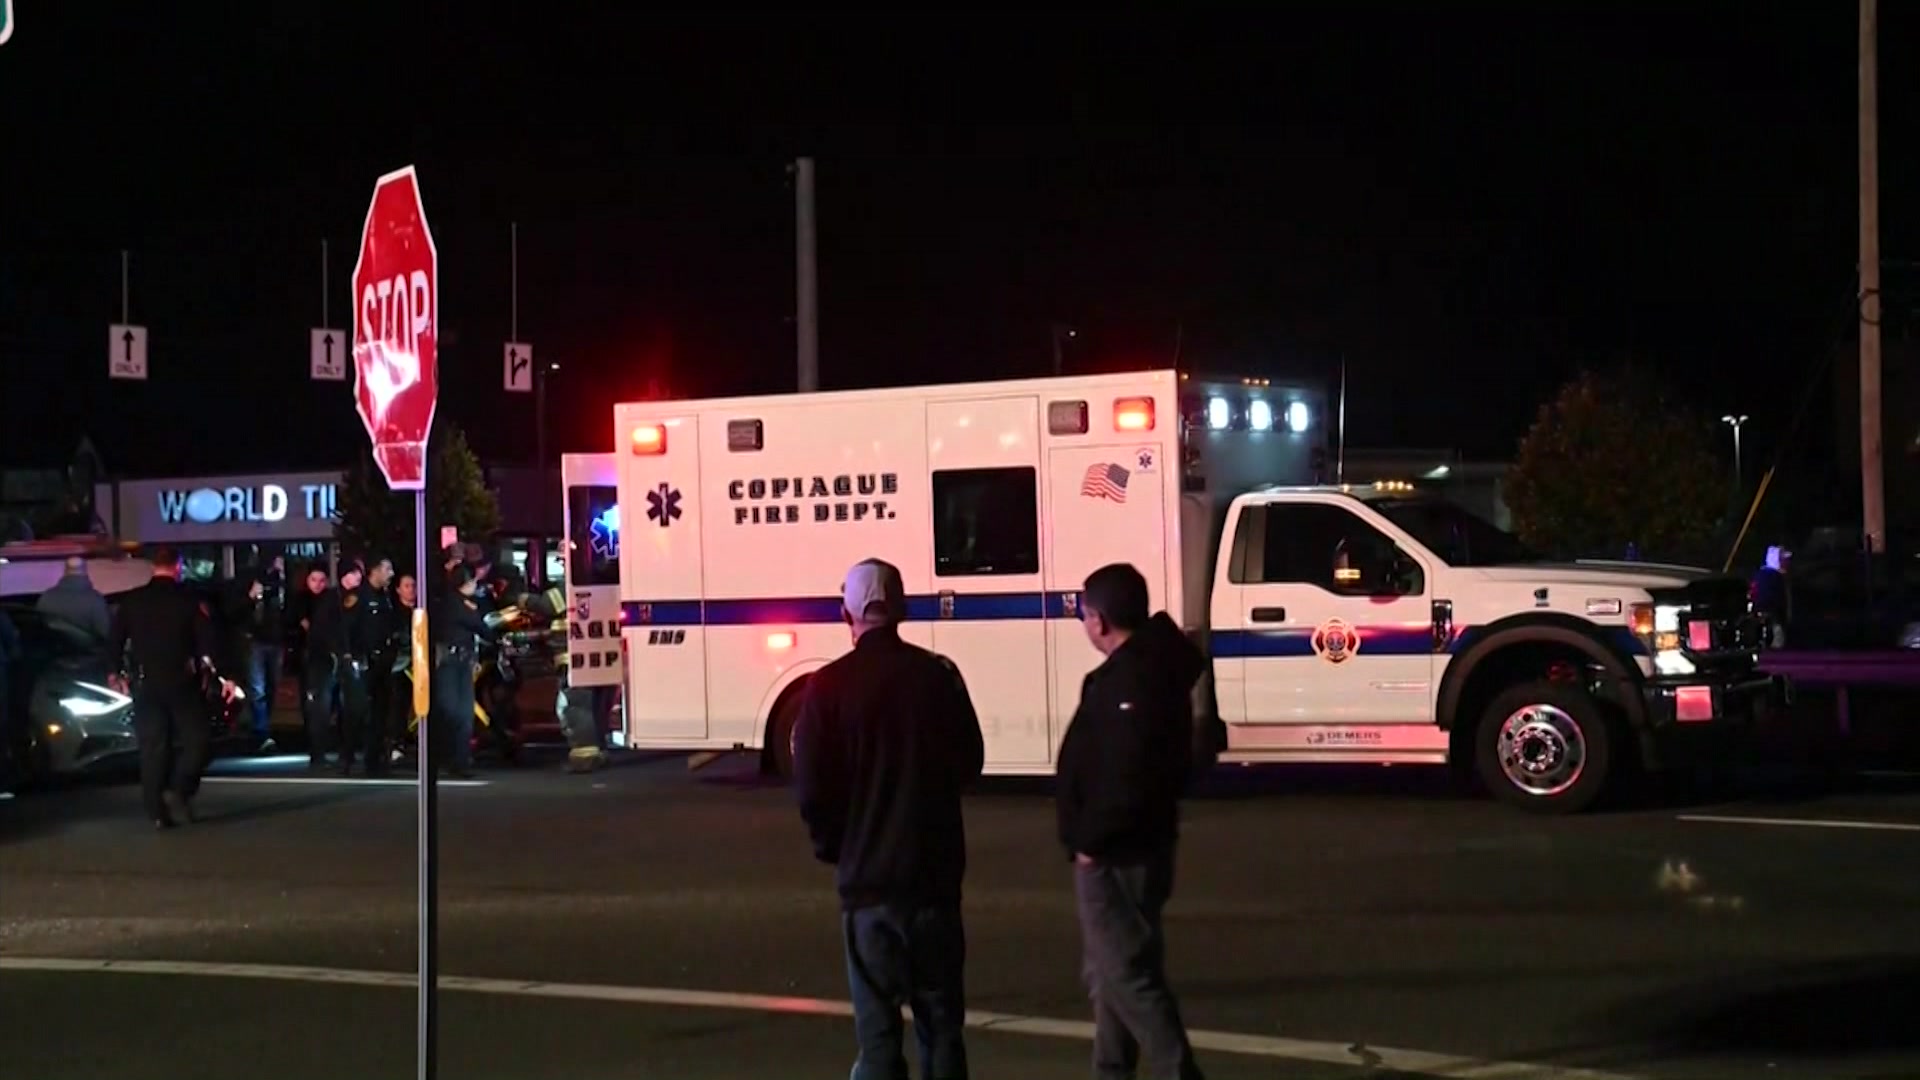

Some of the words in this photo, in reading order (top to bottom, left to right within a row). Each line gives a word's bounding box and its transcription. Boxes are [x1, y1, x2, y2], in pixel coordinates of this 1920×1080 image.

[361, 269, 431, 383] STOP
[728, 473, 898, 500] COPIAGUE
[158, 484, 288, 523] WORLD
[734, 505, 800, 525] FIRE
[814, 501, 896, 522] DEPT.
[648, 629, 686, 646] EMS
